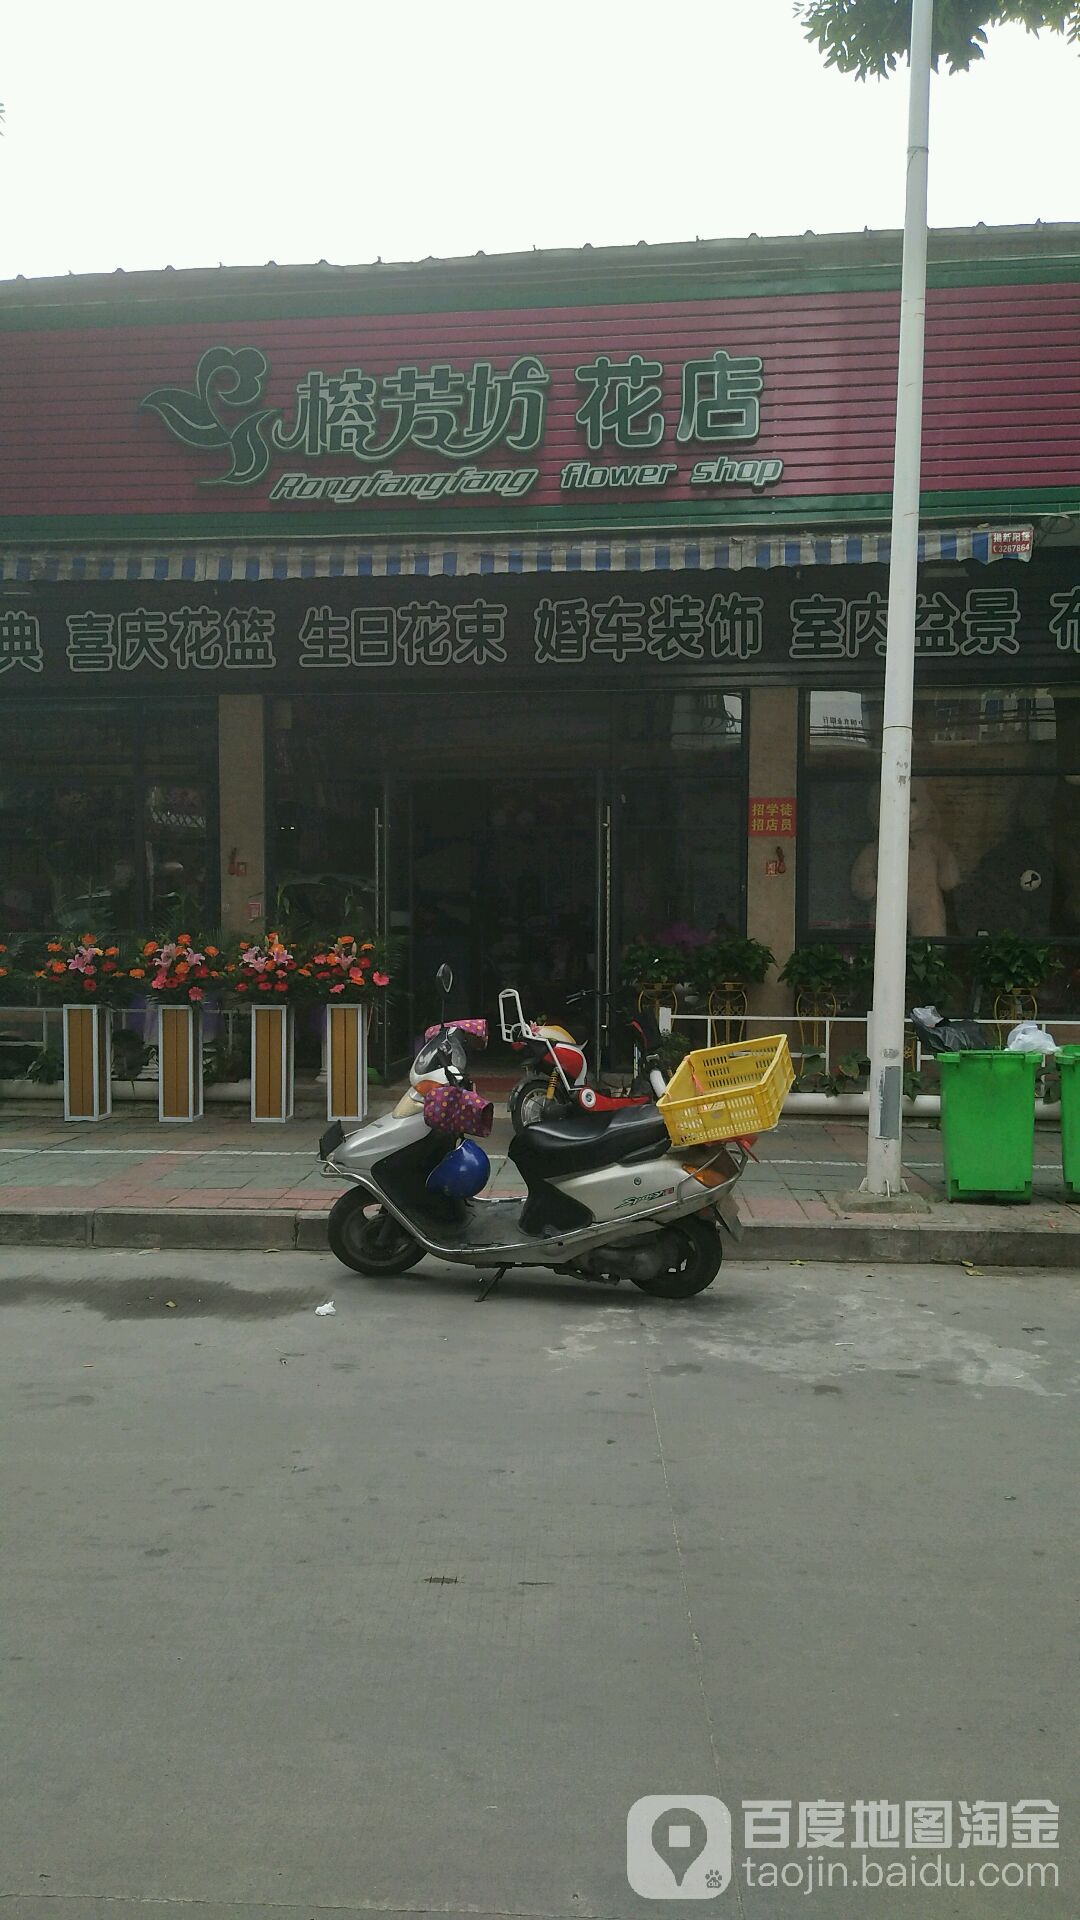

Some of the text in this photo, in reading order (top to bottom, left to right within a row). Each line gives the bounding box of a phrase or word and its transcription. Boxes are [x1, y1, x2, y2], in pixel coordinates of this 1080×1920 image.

[272, 350, 764, 460] 榕芳坊 花店
[269, 456, 783, 502] Rongfangfang flower shop
[66, 605, 276, 672] 喜庆花篮
[299, 598, 507, 667] 生日花束
[534, 592, 764, 663] 婚车装饰
[789, 588, 1021, 658] 室内盆景
[752, 803, 793, 817] 招学徒
[752, 818, 792, 832] 招店员
